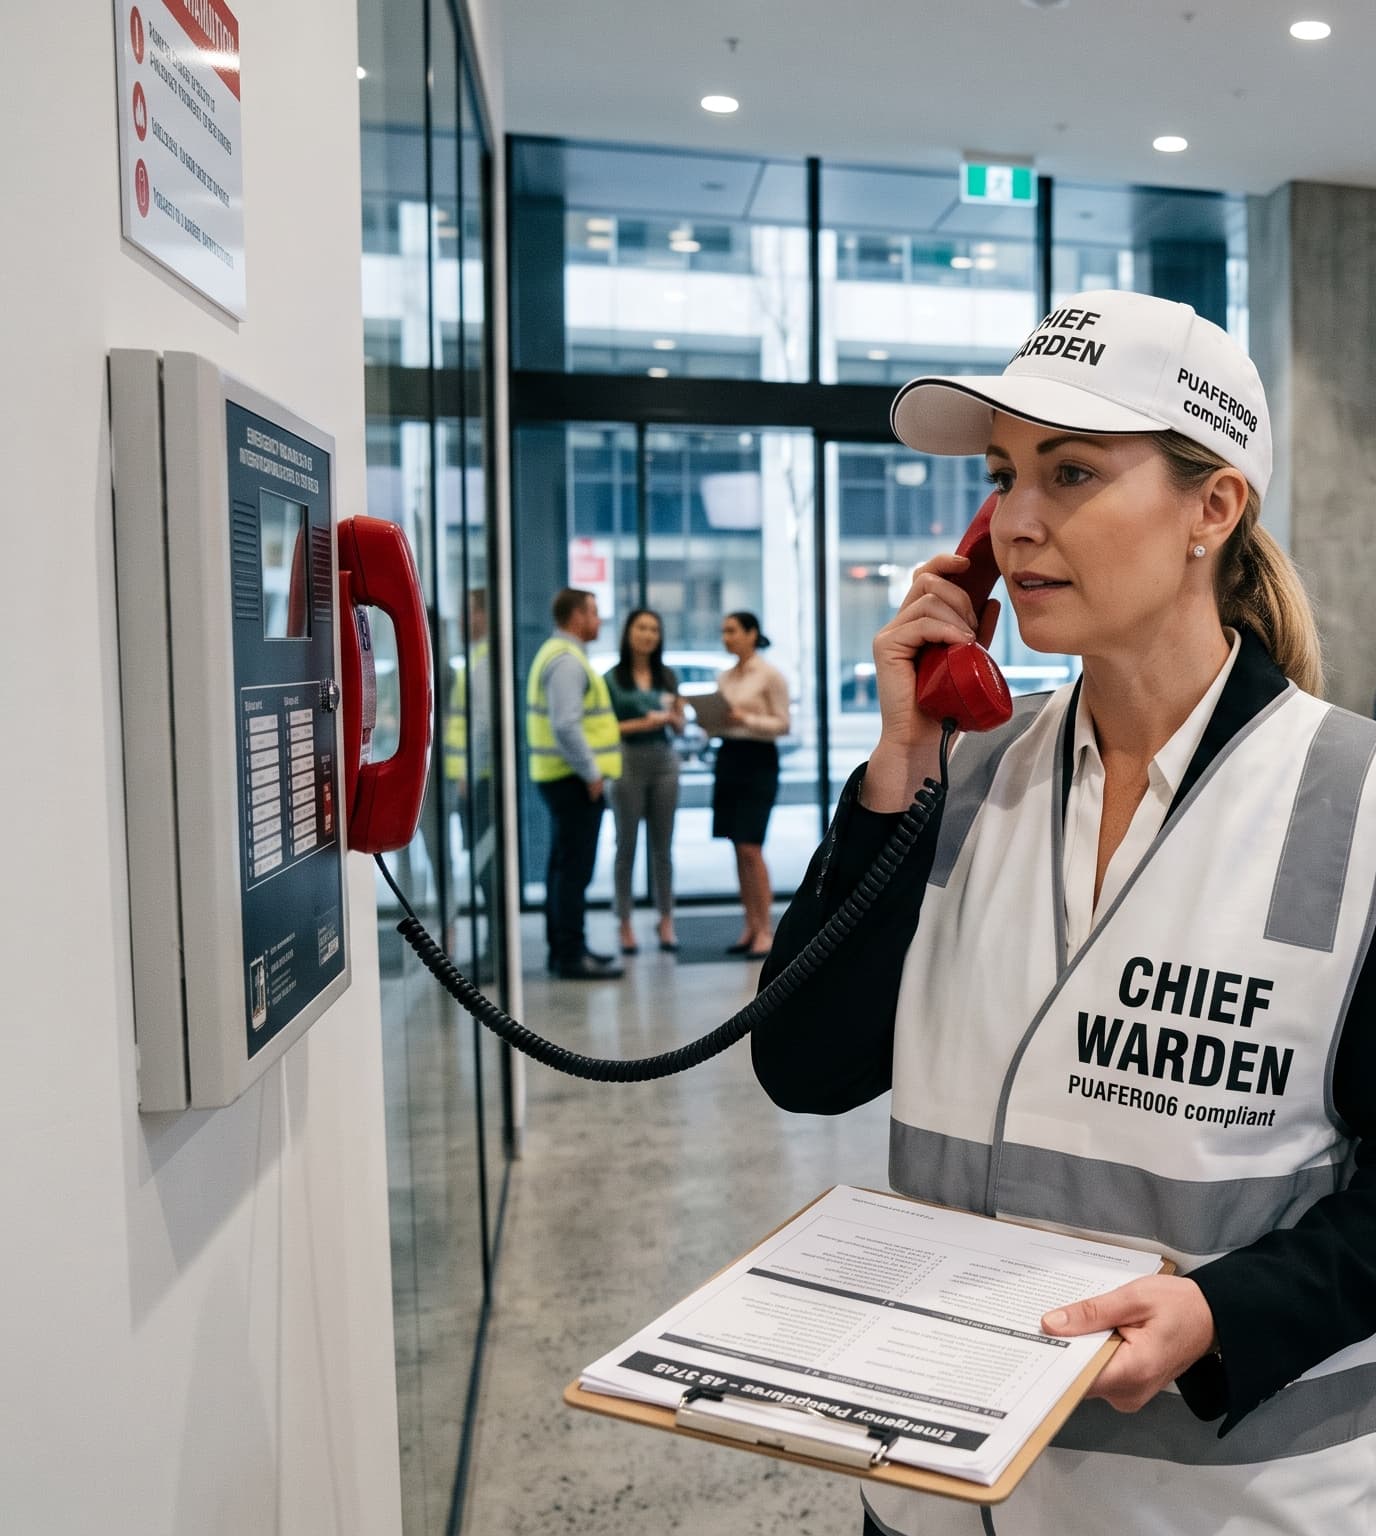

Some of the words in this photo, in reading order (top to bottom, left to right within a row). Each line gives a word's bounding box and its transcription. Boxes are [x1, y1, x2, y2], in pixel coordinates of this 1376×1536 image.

[1034, 309, 1101, 333] HIEF
[1184, 400, 1248, 449] compliant
[1118, 956, 1274, 1028] CHIEF
[1077, 1011, 1295, 1096] WARDEN
[1068, 1074, 1178, 1116] PUAFER006
[1184, 1103, 1276, 1129] compliant
[653, 1363, 700, 1381] 3745
[699, 1374, 727, 1387] AS
